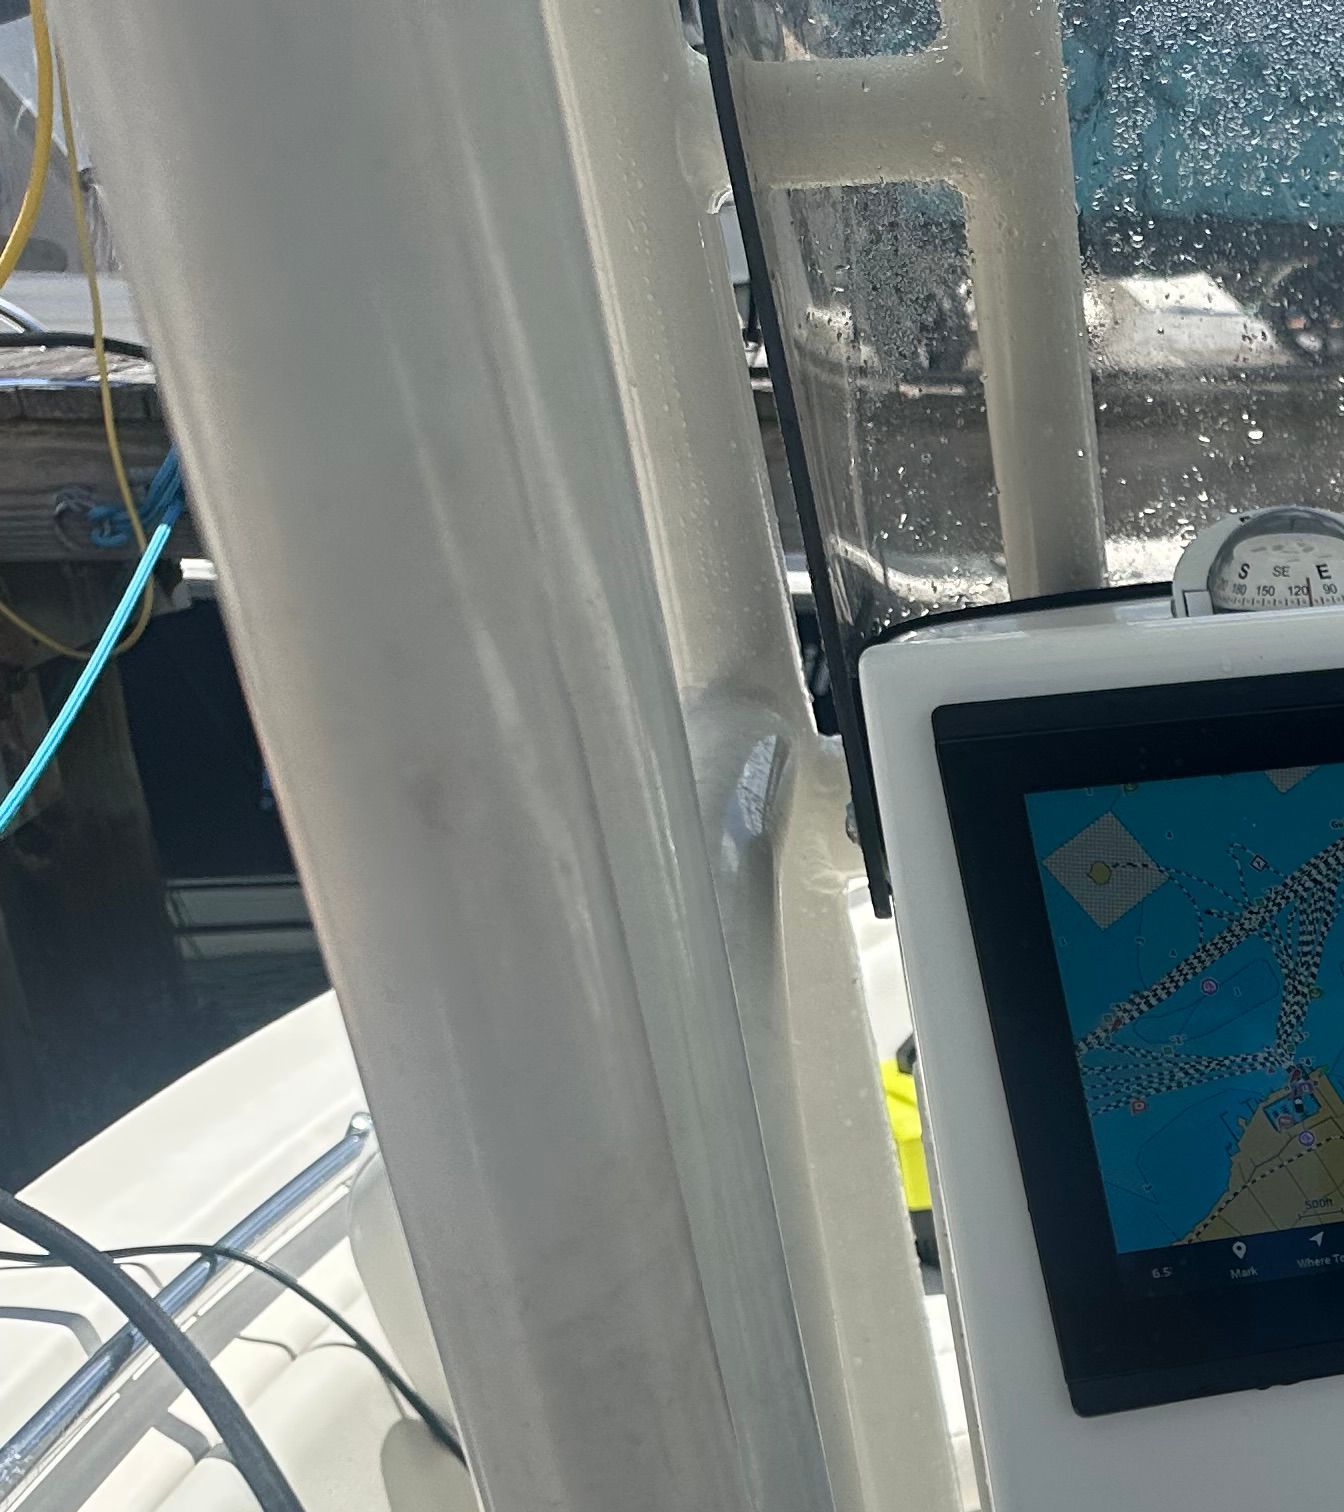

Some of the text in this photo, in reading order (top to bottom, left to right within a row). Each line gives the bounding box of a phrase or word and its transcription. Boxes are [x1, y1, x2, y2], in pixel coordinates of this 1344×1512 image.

[1238, 563, 1250, 580] S
[1272, 565, 1290, 578] SE
[1315, 563, 1332, 580] E
[1256, 585, 1276, 597] 150
[1288, 585, 1310, 596] 120
[1322, 583, 1338, 595] 90
[1296, 1257, 1332, 1269] Where
[1229, 1267, 1259, 1280] Mark
